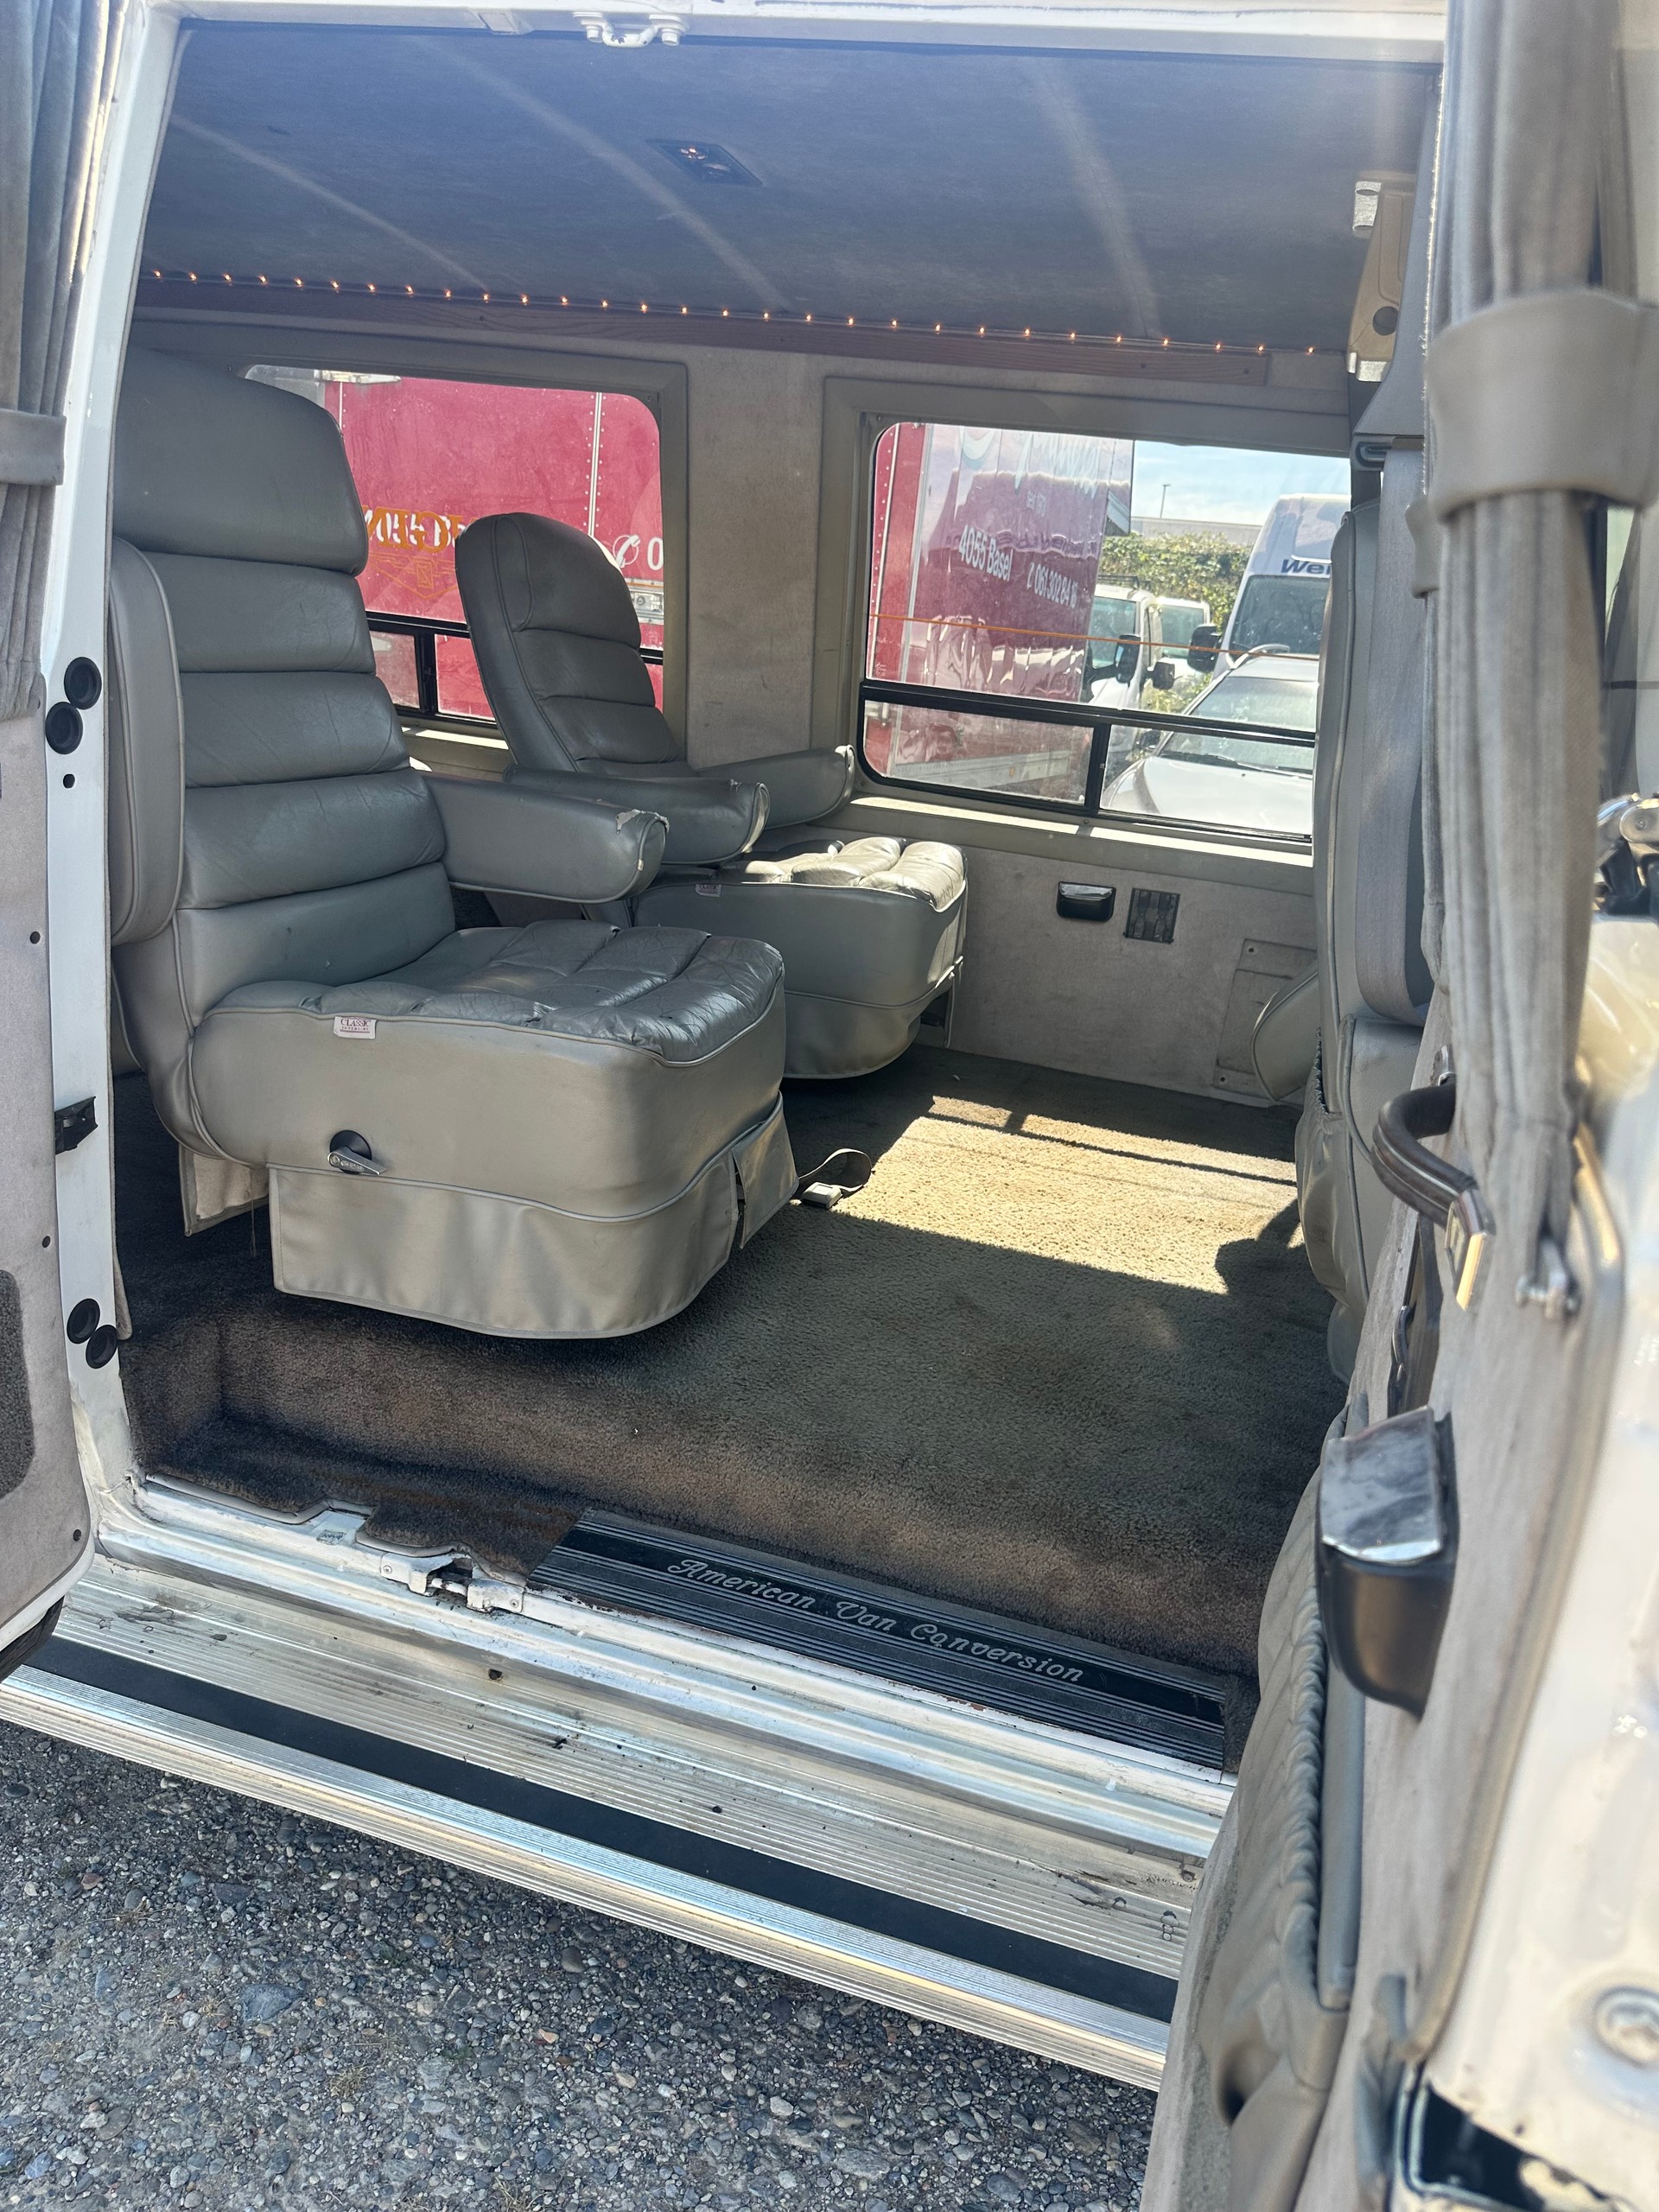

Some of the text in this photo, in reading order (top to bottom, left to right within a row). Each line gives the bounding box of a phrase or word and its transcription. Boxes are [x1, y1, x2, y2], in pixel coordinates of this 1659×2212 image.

[958, 524, 1014, 582] 4055 Basel
[667, 1559, 1084, 1682] American Van Conversion
